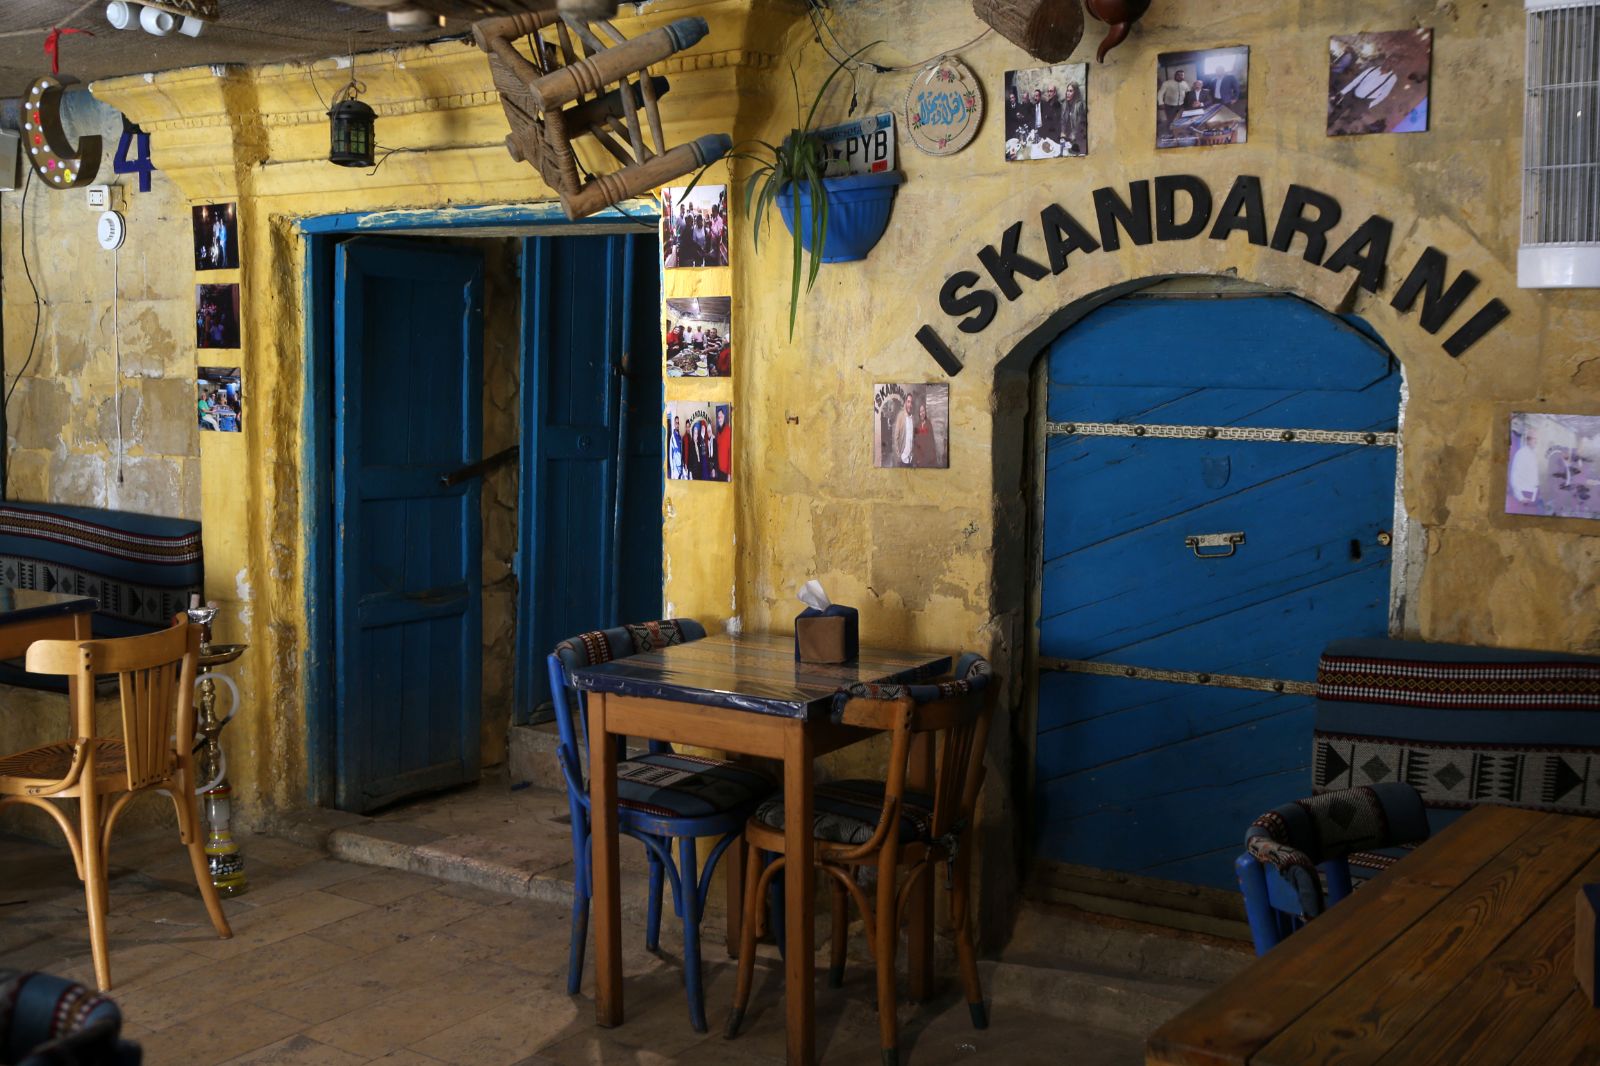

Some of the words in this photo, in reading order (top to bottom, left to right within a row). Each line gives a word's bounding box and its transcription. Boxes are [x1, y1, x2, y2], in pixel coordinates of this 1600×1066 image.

[113, 124, 155, 193] 4
[846, 129, 888, 163] PYB
[914, 174, 1511, 377] ISKANDARANI
